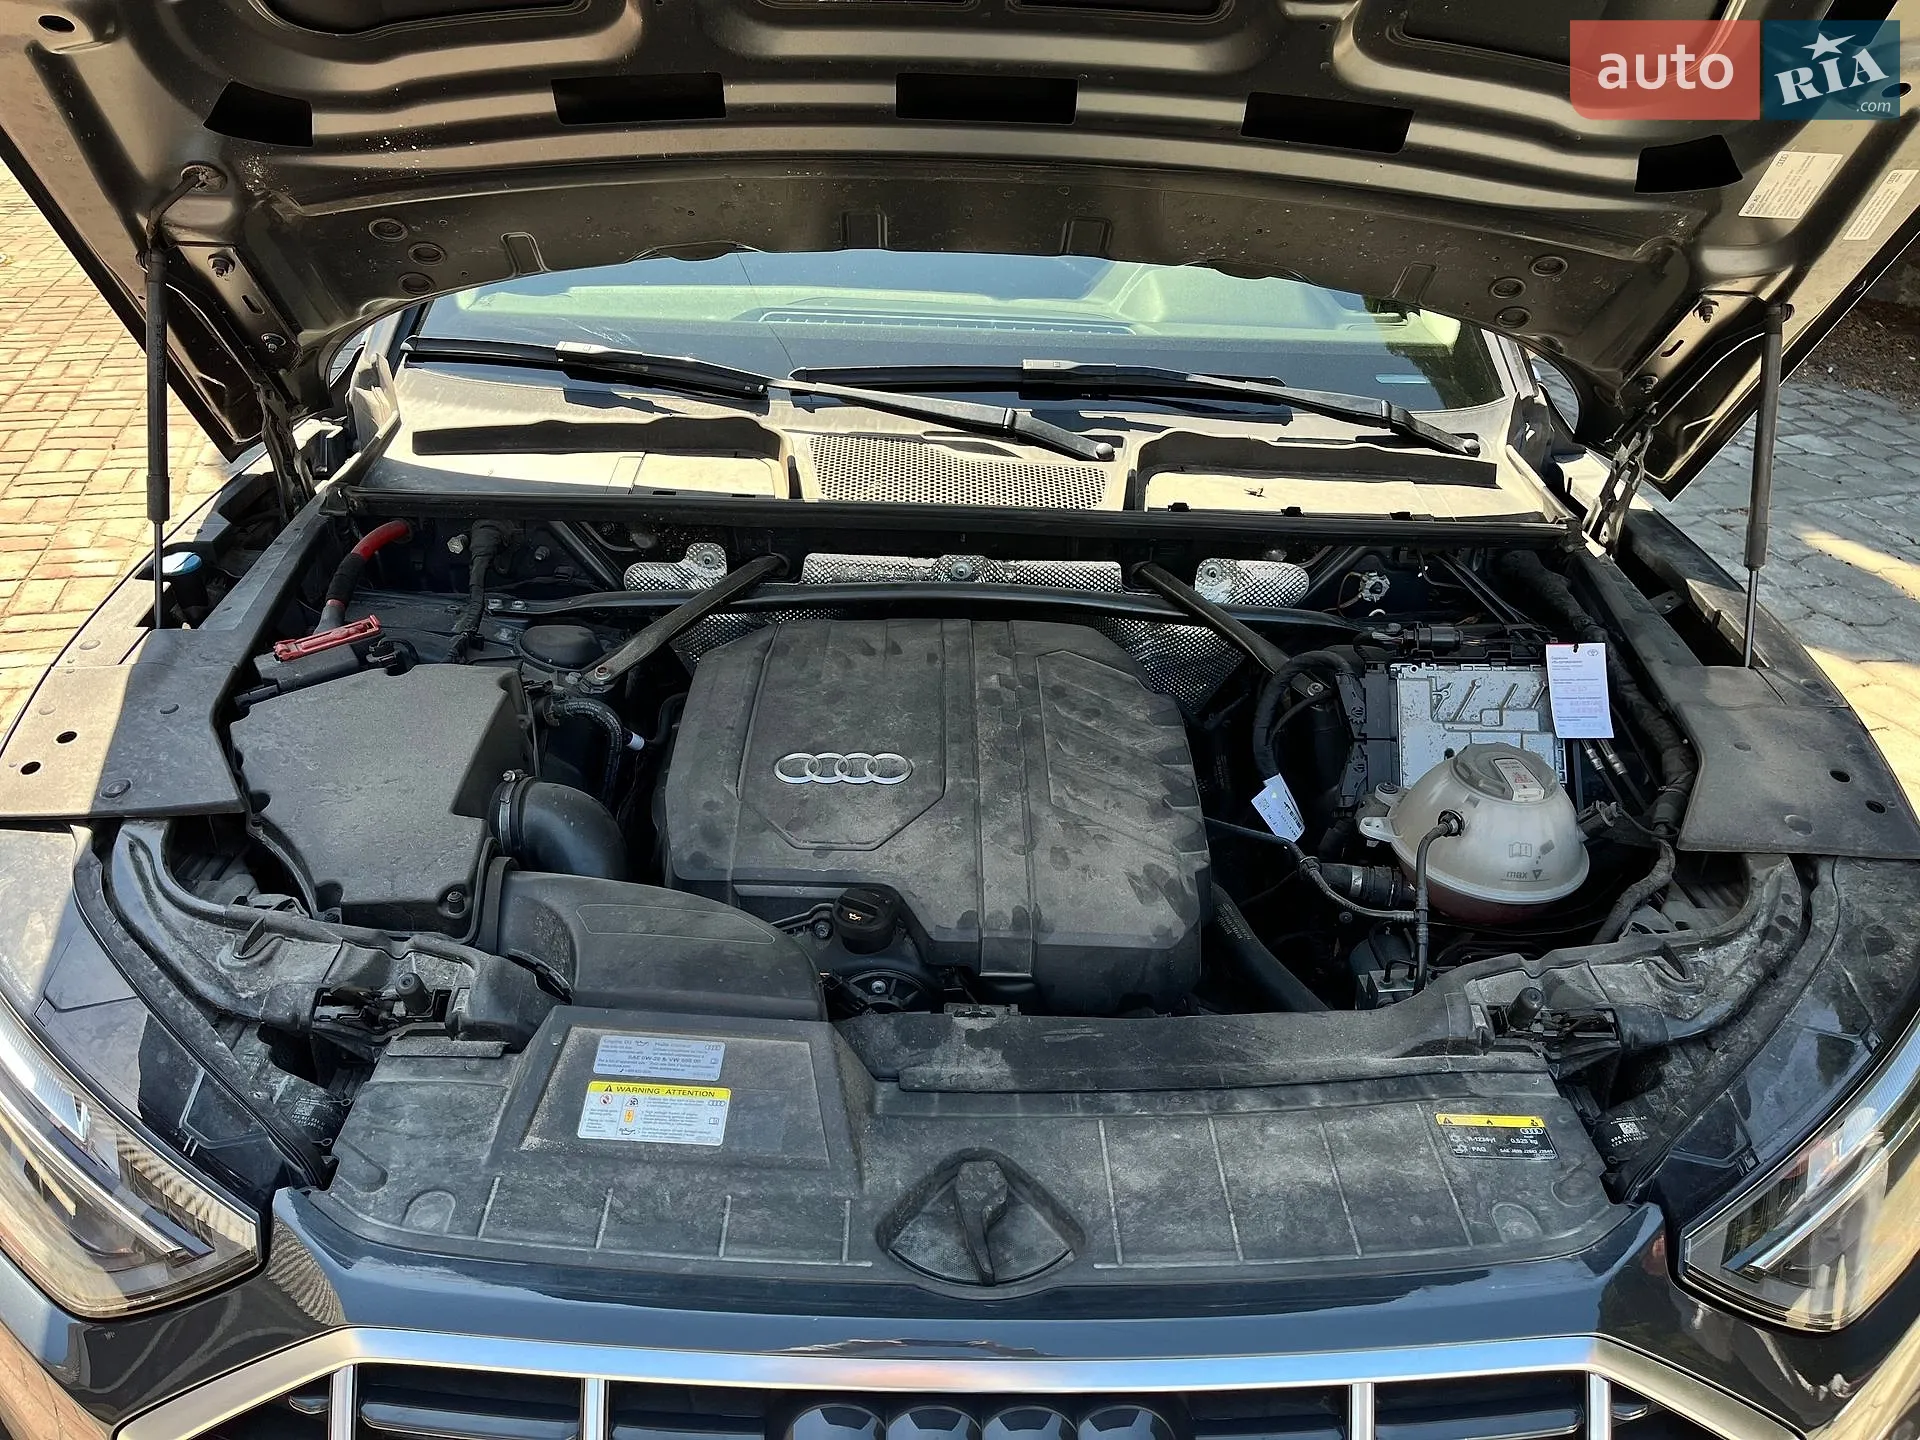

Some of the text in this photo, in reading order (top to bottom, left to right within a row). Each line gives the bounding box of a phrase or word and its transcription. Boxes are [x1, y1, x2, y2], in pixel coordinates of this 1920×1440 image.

[1506, 870, 1528, 879] max
[616, 1086, 716, 1097] WARNING ATTENTION
